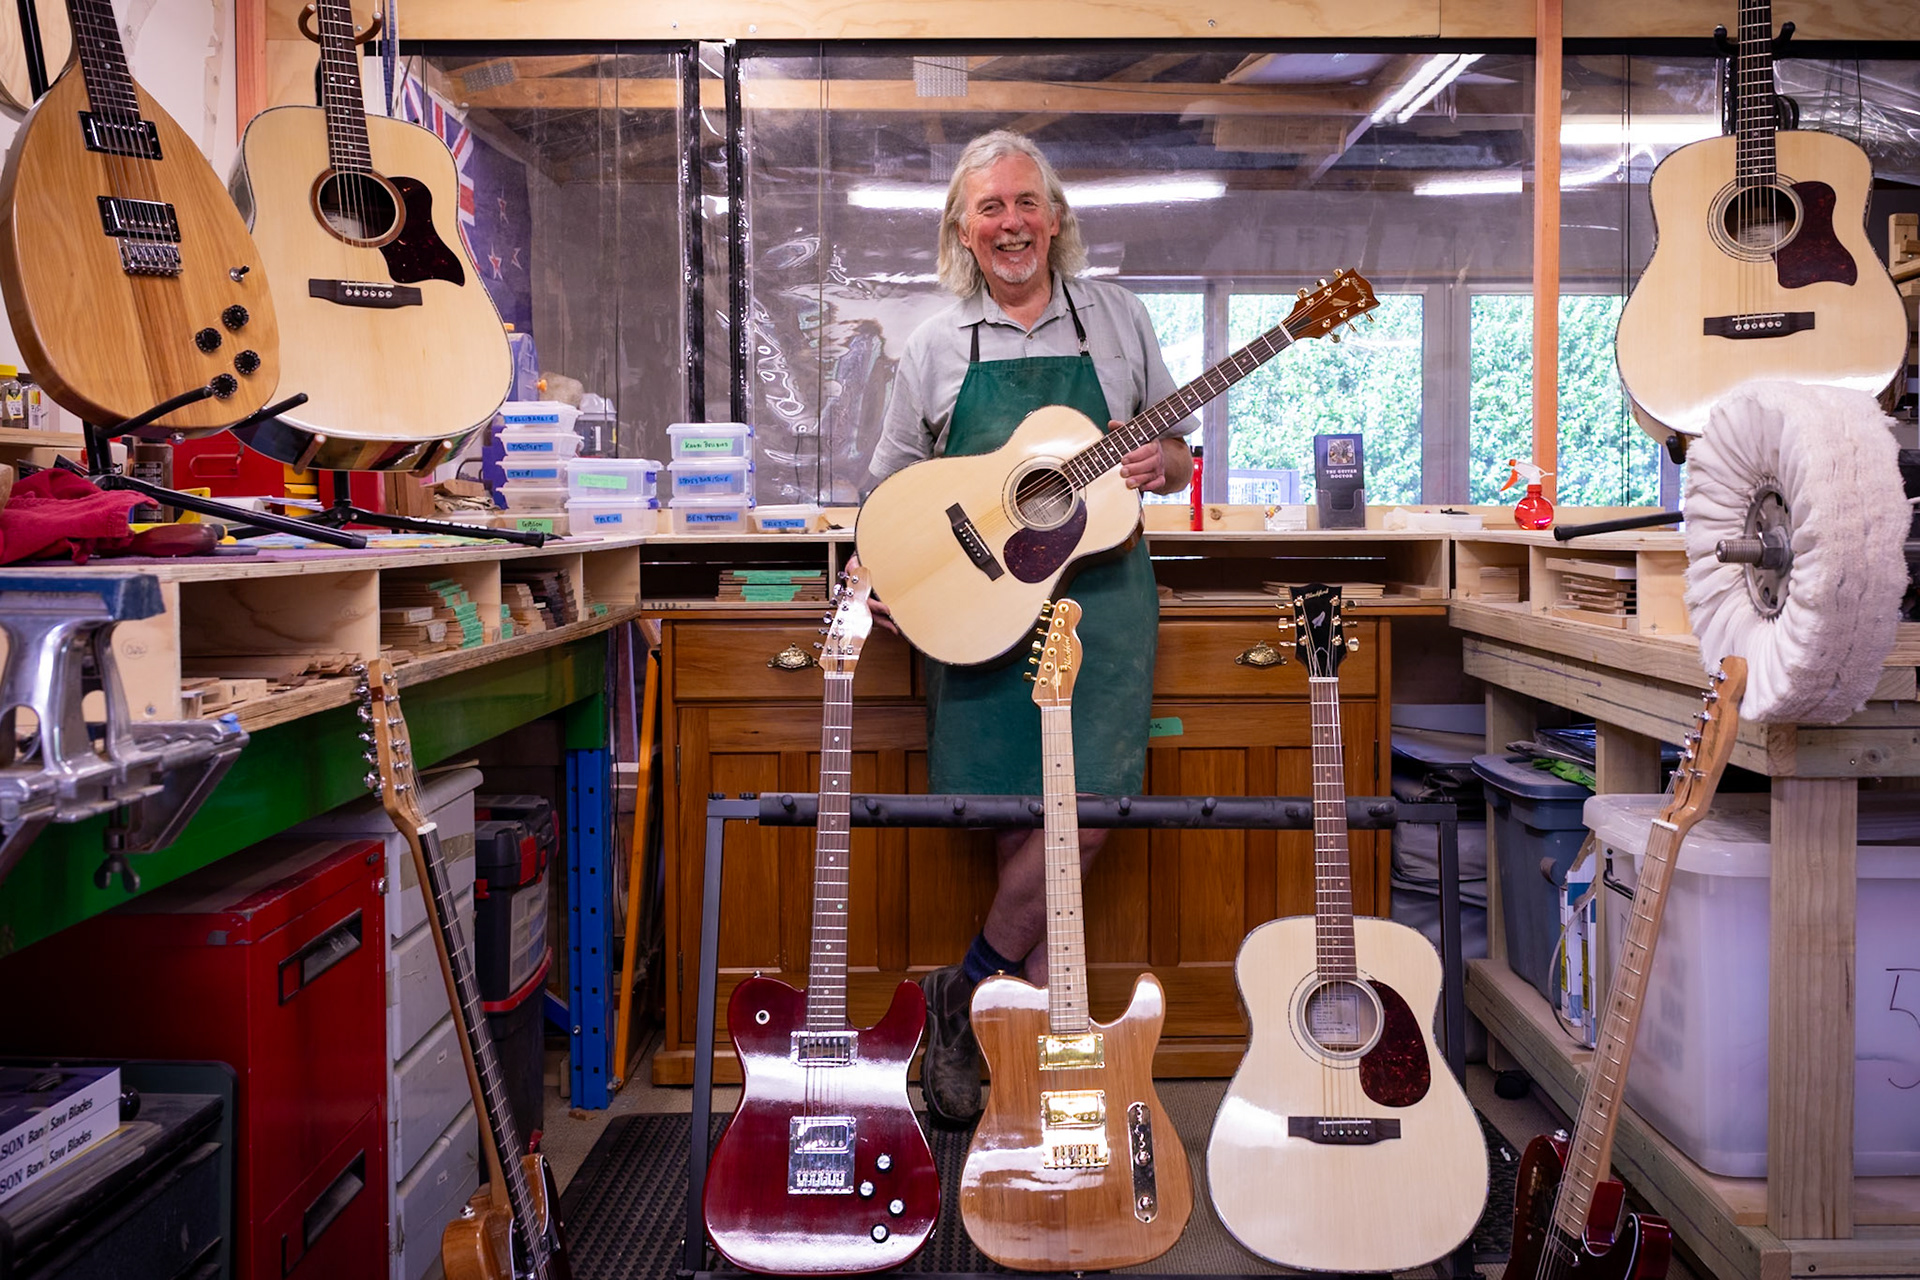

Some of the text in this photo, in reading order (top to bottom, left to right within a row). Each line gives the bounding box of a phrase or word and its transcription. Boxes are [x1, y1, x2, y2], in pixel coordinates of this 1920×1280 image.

[50, 1113, 67, 1131] Saw
[69, 1097, 93, 1120] Blades
[49, 1145, 66, 1164] Saw
[67, 1130, 92, 1153] Blades
